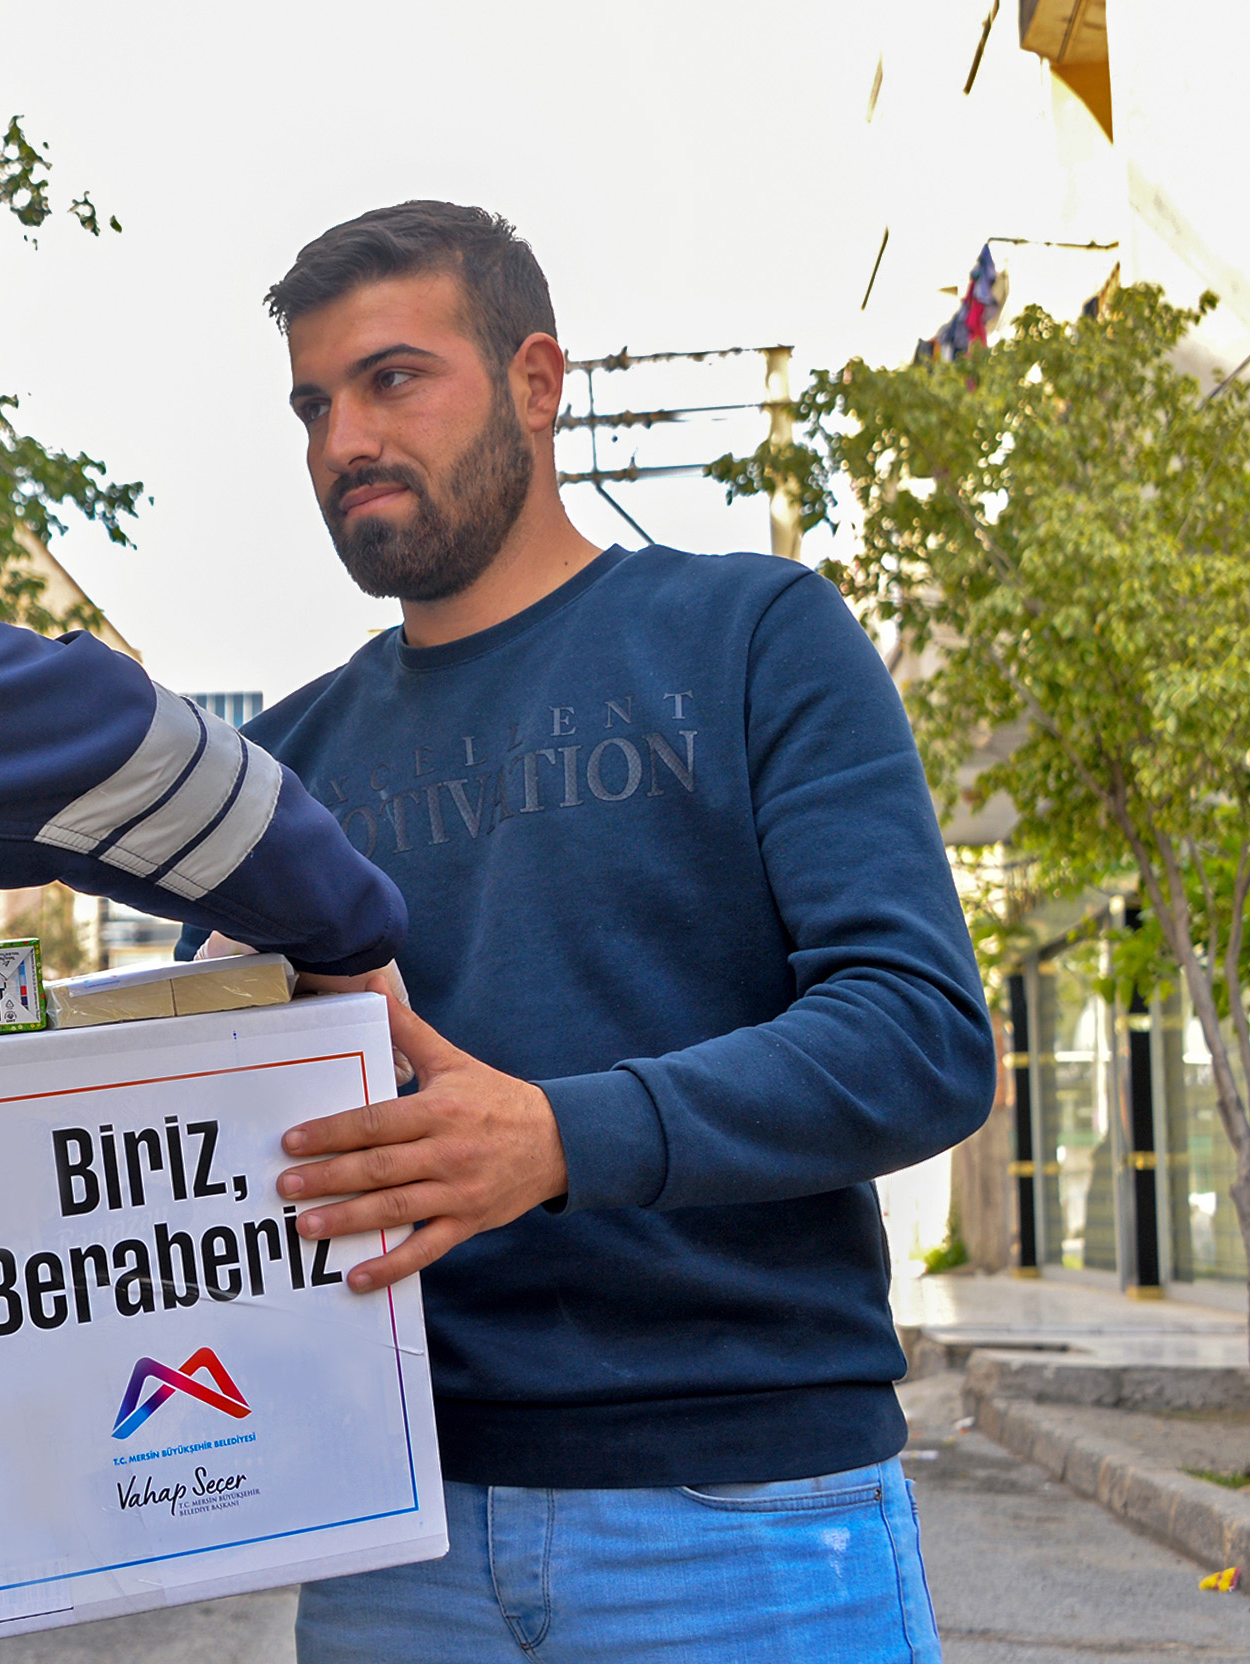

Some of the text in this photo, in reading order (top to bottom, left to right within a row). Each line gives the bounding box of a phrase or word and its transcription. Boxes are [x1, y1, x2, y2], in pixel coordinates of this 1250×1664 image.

[323, 689, 694, 807] XCELLENT
[340, 730, 700, 860] OTIVATION
[52, 1115, 249, 1218] Biriz,
[113, 1432, 257, 1466] T.C. MERSİN BÜYÜKŞEHİR BELEDİYESİ
[116, 1466, 247, 1516] Vahap Seçer
